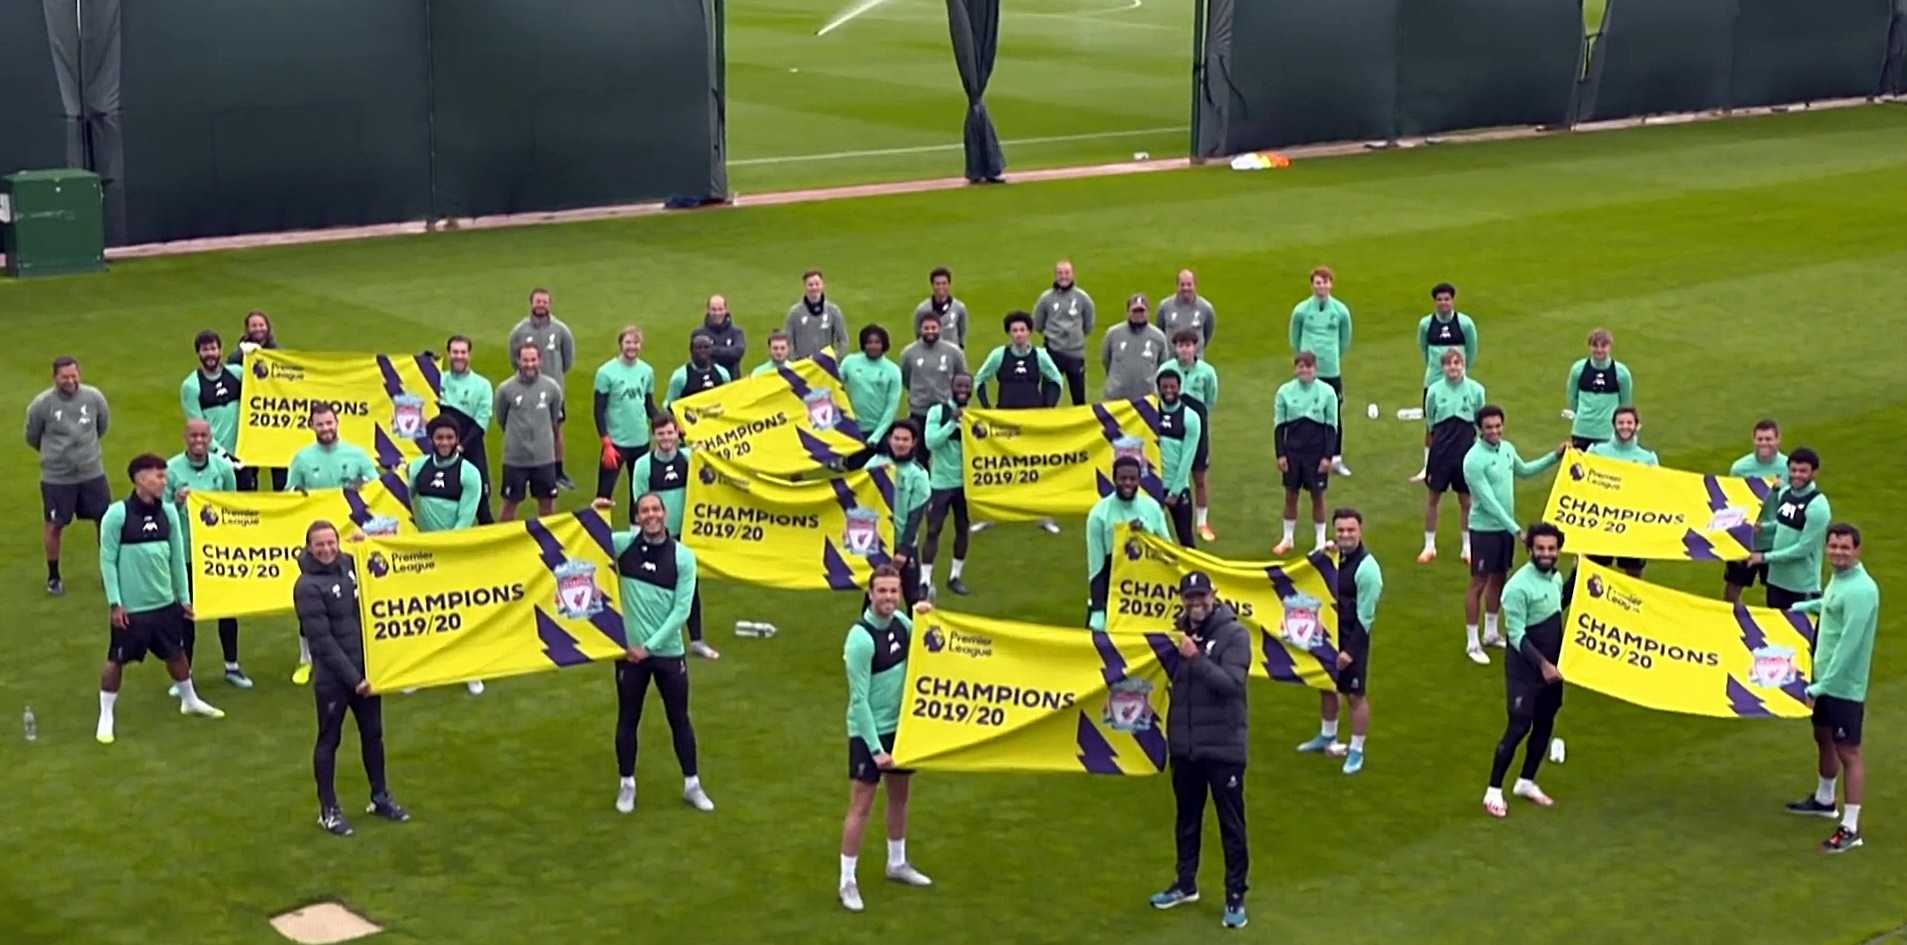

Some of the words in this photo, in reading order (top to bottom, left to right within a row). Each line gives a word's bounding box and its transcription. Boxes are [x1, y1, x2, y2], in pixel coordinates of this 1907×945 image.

[972, 450, 1089, 470] CHAMPIONS
[973, 469, 1039, 486] 2019/20
[694, 503, 820, 528] CHAMPIONS
[1554, 510, 1627, 534] 2019/20
[1559, 495, 1685, 525] CHAMPIONS
[692, 521, 764, 541] 2019/20
[204, 560, 280, 579] 2019/20
[391, 552, 434, 564] Premier
[391, 561, 435, 574] League
[371, 583, 525, 618] CHAMPIONS
[374, 613, 462, 640] 2019/20
[950, 631, 992, 646] Premier
[949, 643, 992, 658] League
[1574, 630, 1652, 669] 2019/20
[1577, 613, 1719, 666] CHAMPIONS
[916, 676, 1075, 709] CHAMPIONS
[913, 699, 1005, 726] 2019/20
